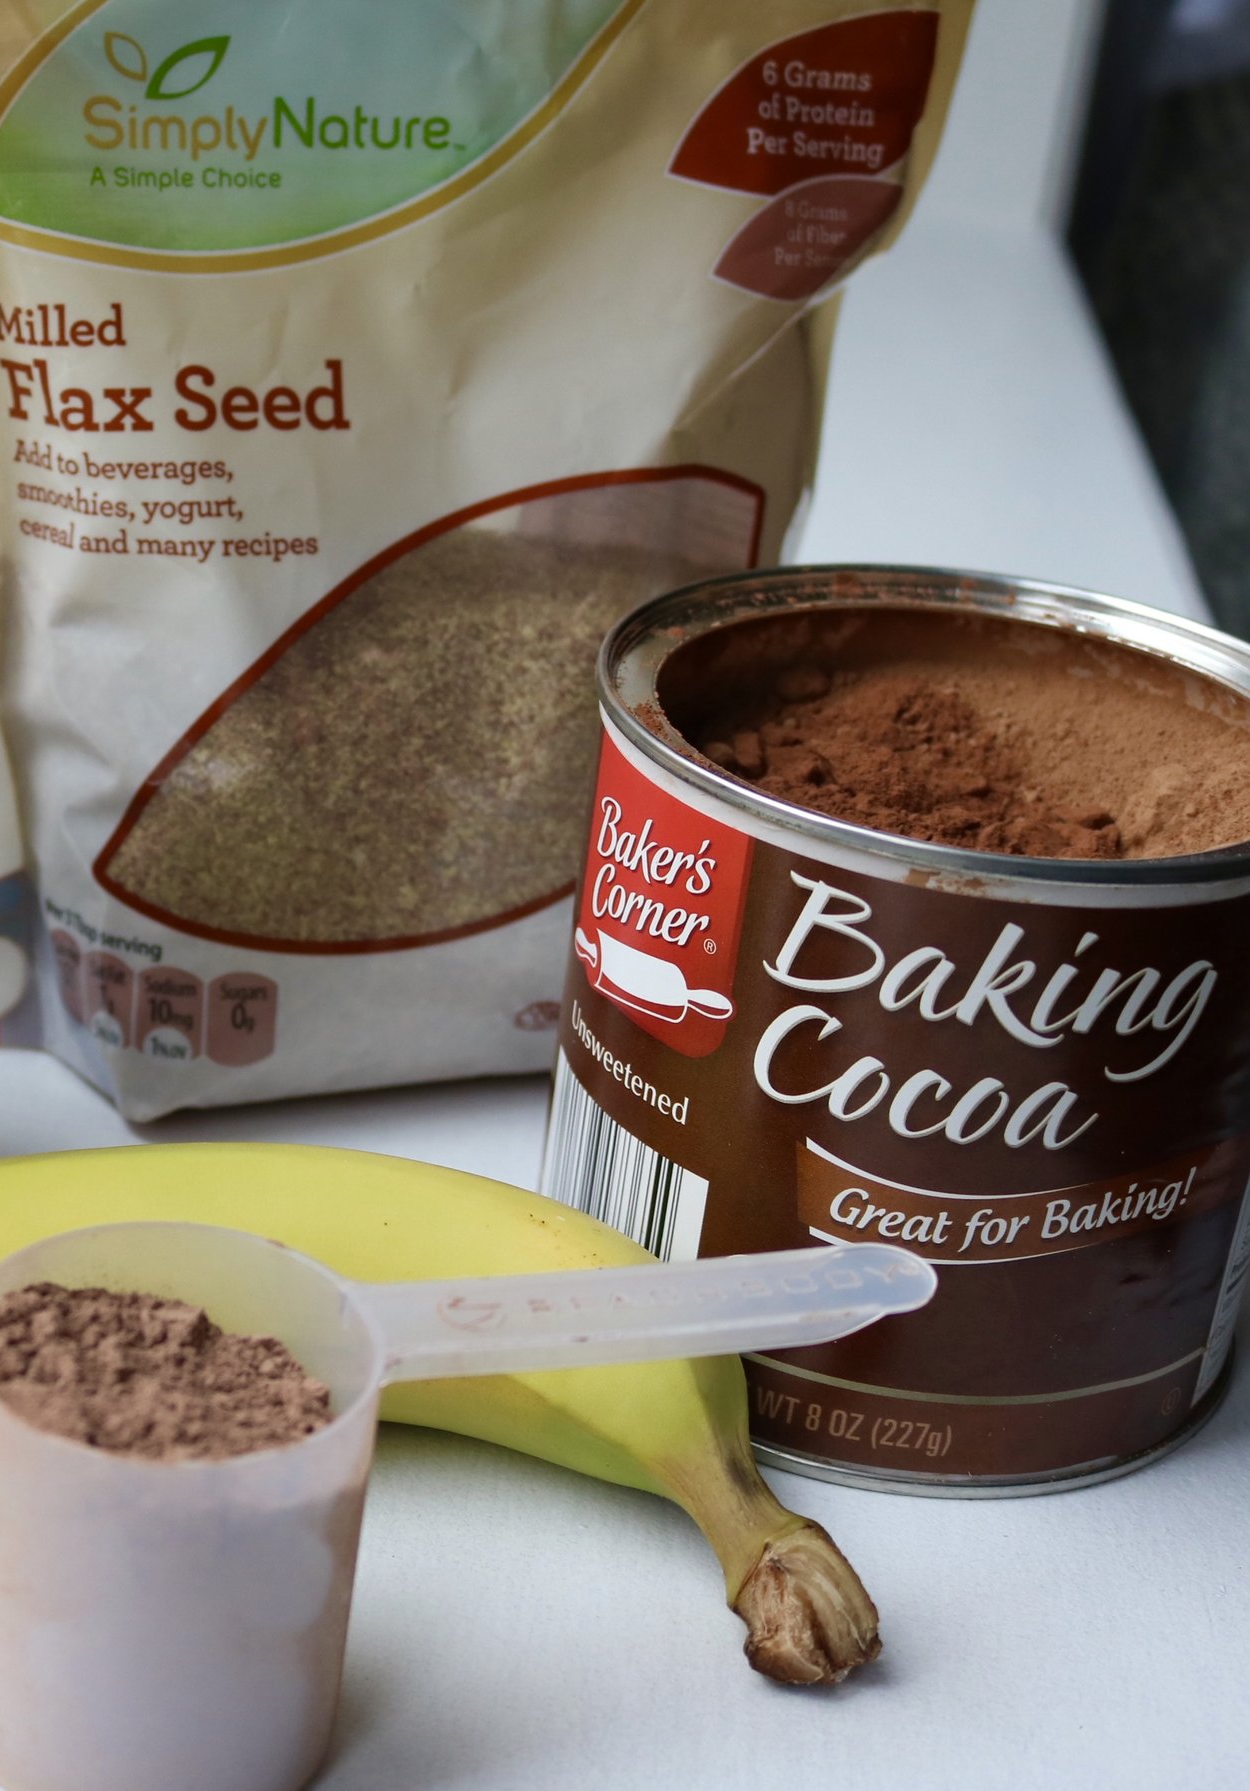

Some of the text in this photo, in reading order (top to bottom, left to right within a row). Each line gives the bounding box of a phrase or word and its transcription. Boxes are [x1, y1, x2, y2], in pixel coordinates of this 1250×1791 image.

[762, 60, 873, 92] 6 Grams
[758, 93, 875, 127] of Protein
[746, 127, 885, 168] Per Serving
[89, 167, 282, 190] A Simple Choice
[0, 358, 351, 432] Flax Seed
[14, 439, 234, 485] Add to beverages,
[17, 482, 244, 525] smoothies, yogurt,
[19, 517, 319, 564] cereal and many recipes
[596, 796, 716, 894] Baker's
[592, 864, 709, 946] Corner
[102, 931, 162, 962] serving
[763, 870, 1217, 1083] Baking
[572, 1000, 689, 1125] Unsweetened
[754, 1004, 1100, 1150] Cocoa
[829, 1167, 1197, 1253] Great for Baking!
[756, 1386, 952, 1457] WT 8 OZ (227g)
